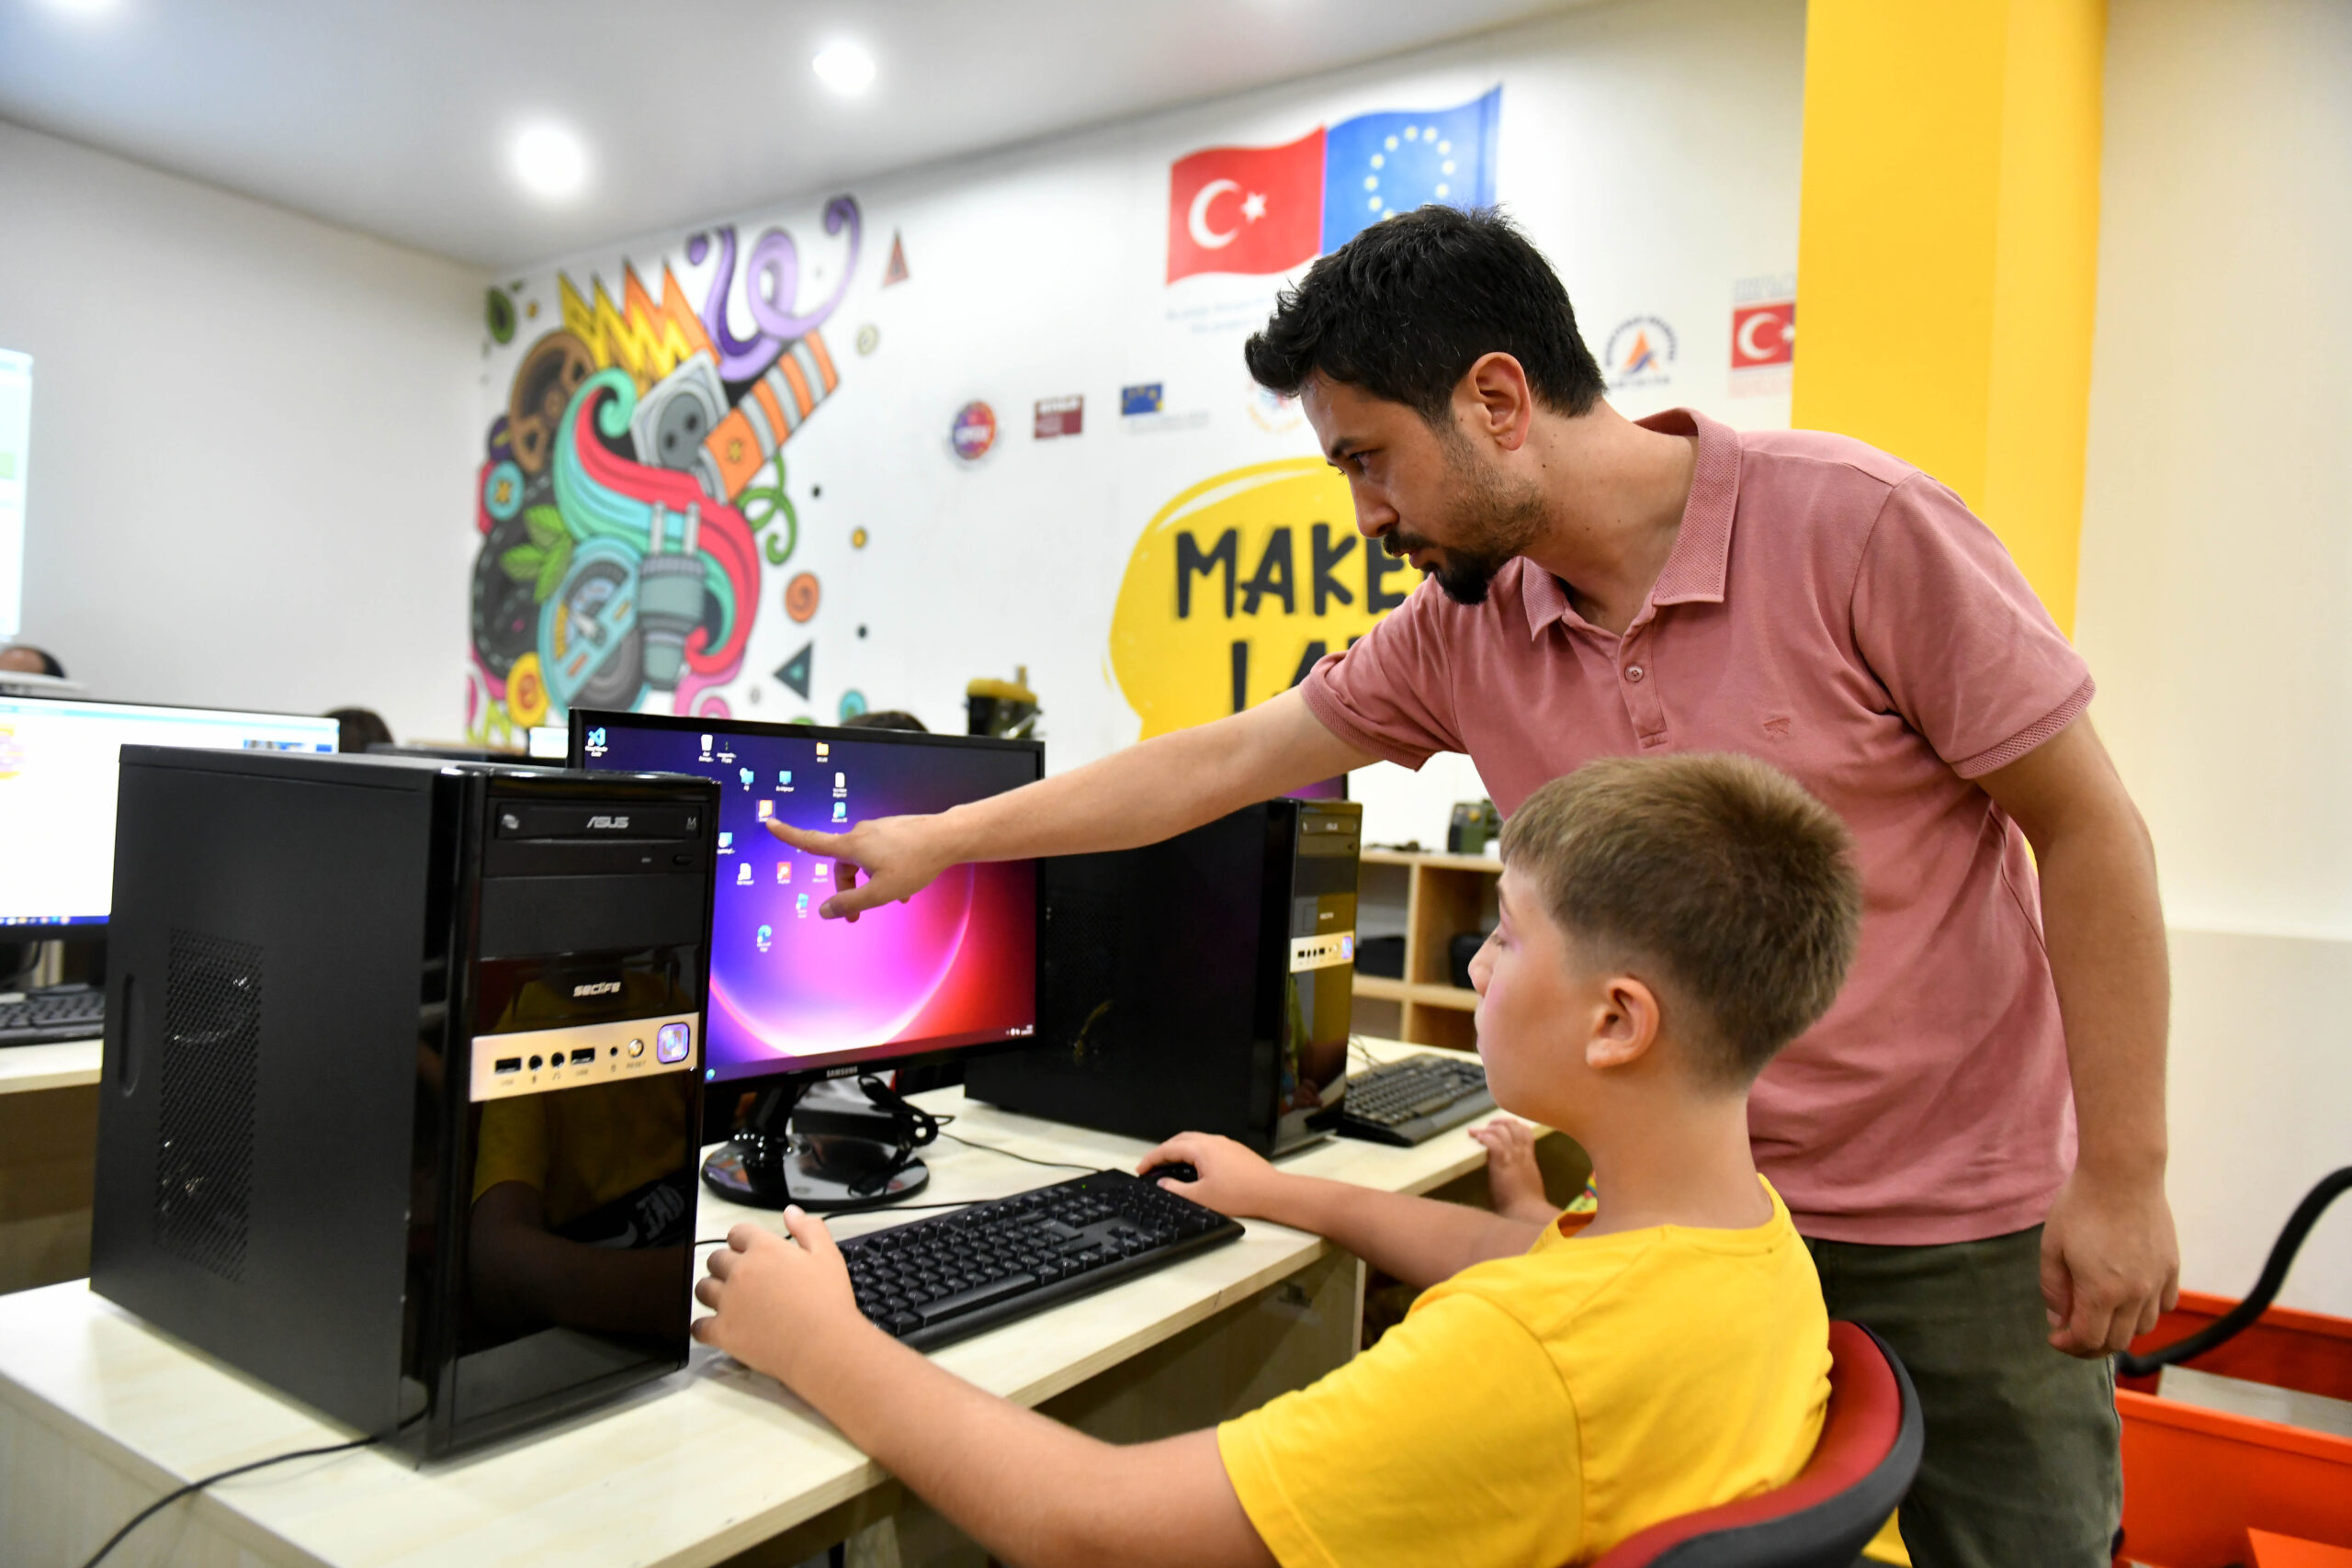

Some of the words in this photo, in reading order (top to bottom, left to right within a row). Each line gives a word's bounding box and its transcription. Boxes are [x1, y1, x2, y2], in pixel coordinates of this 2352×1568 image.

[1173, 522, 1426, 620] MAKE
[586, 816, 629, 829] ASUS
[826, 1066, 858, 1078] SAMSUNG
